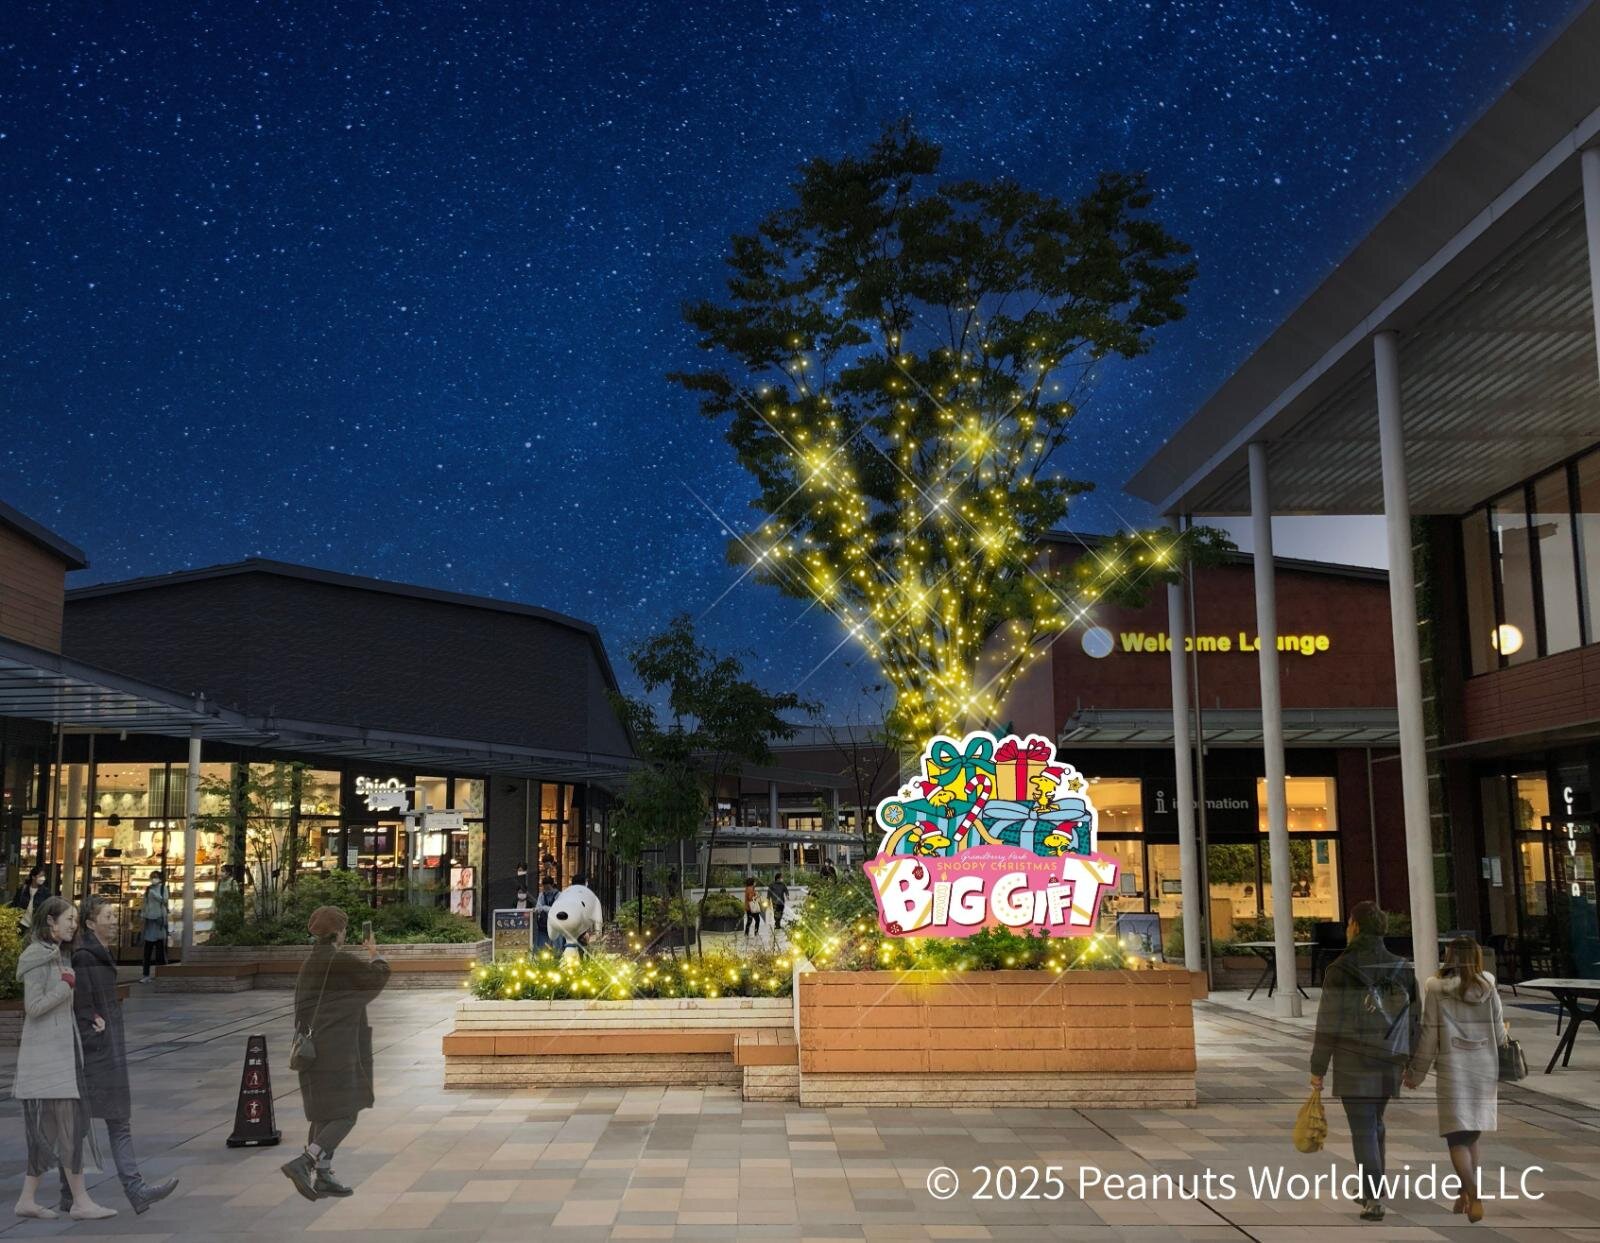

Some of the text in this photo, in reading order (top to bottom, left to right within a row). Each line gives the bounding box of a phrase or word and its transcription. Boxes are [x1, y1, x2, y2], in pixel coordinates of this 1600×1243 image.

[1172, 798, 1249, 809] iomation
[937, 862, 1058, 872] SNOOPY CHRISTMAS
